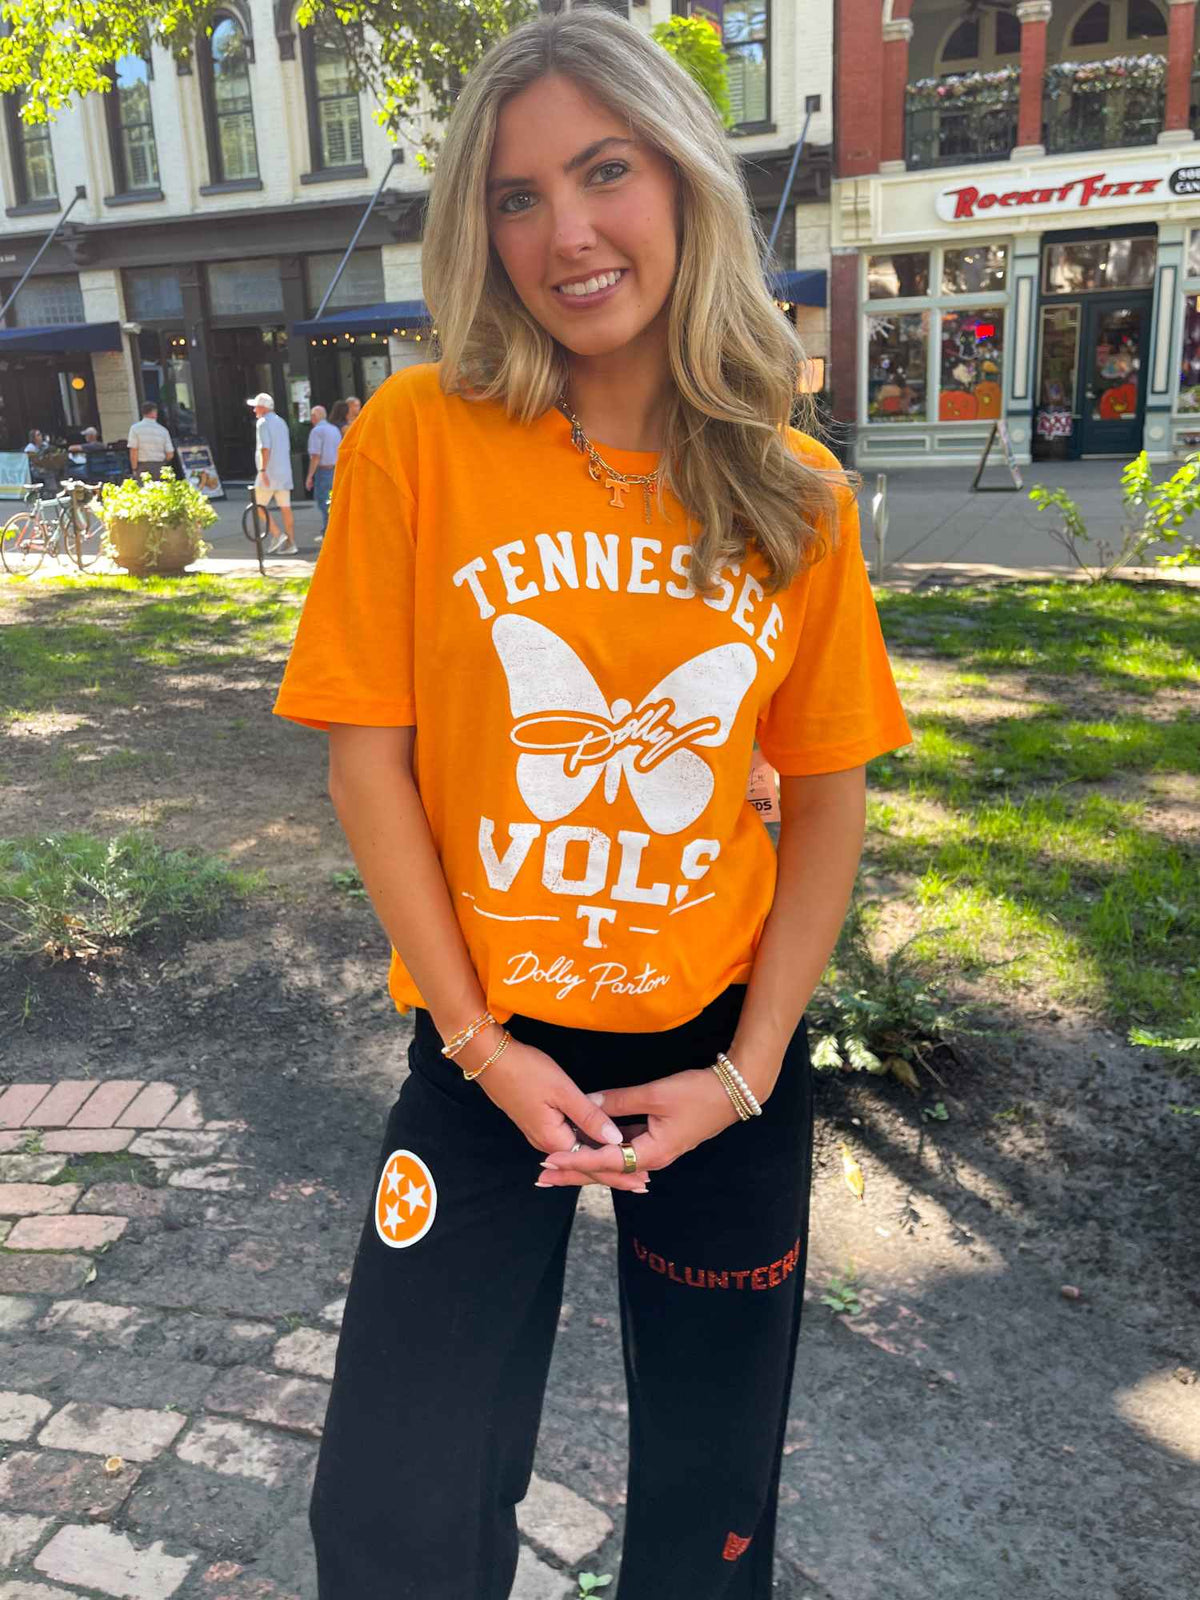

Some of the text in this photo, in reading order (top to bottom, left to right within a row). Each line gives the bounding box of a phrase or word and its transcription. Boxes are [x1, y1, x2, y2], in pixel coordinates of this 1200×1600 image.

[605, 478, 630, 509] T
[452, 531, 784, 662] TENNESSEE
[510, 703, 717, 772] Dolly
[478, 815, 721, 907] VOLS
[576, 904, 617, 949] T
[503, 951, 671, 1001] Dolly Parton
